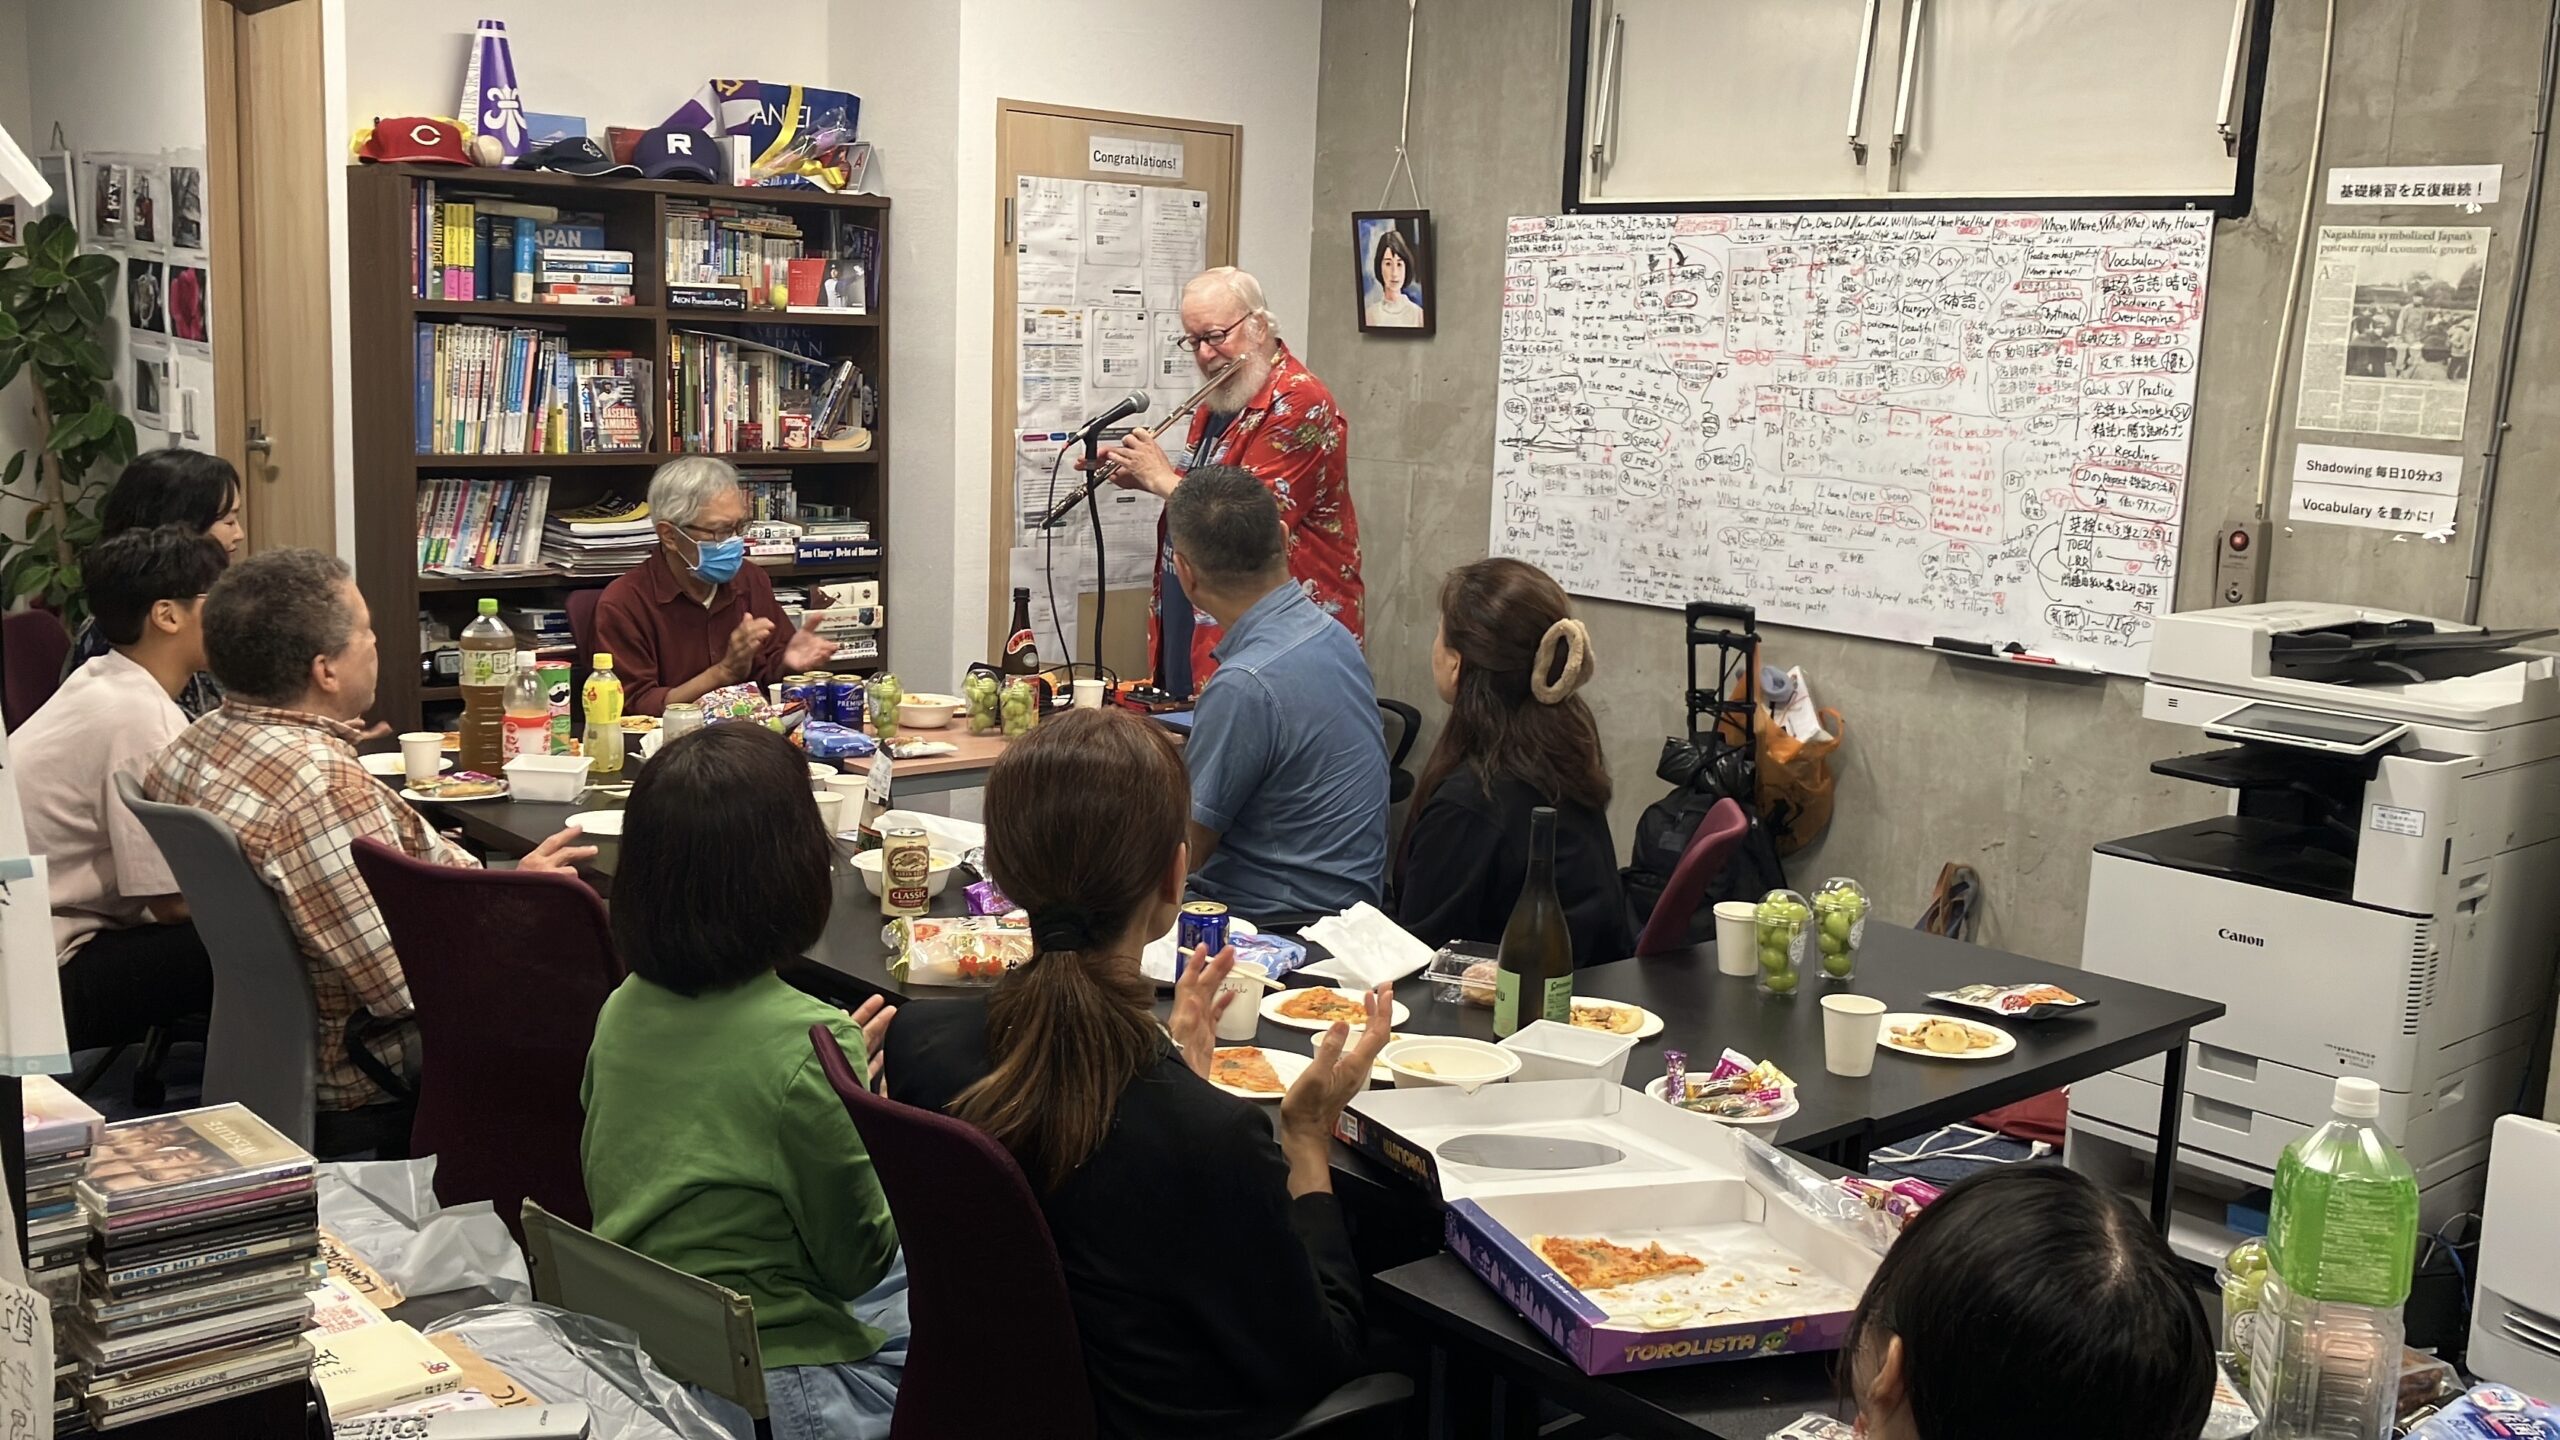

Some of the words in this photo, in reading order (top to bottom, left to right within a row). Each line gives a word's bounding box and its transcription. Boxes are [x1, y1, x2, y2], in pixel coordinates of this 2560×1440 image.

[667, 133, 692, 155] R
[1093, 149, 1176, 169] Congratulations!
[2107, 253, 2169, 269] Vocabulary
[1906, 276, 1935, 292] sleepy
[2306, 459, 2372, 478] Shadowing
[2302, 498, 2372, 518] Vocabulary
[892, 891, 927, 900] CLASSIC
[2218, 928, 2265, 948] Canon
[122, 1263, 170, 1280] BEST
[173, 1256, 200, 1270] HIT
[204, 1248, 248, 1263] POPS
[1624, 1334, 1757, 1363] TOROLISTA
